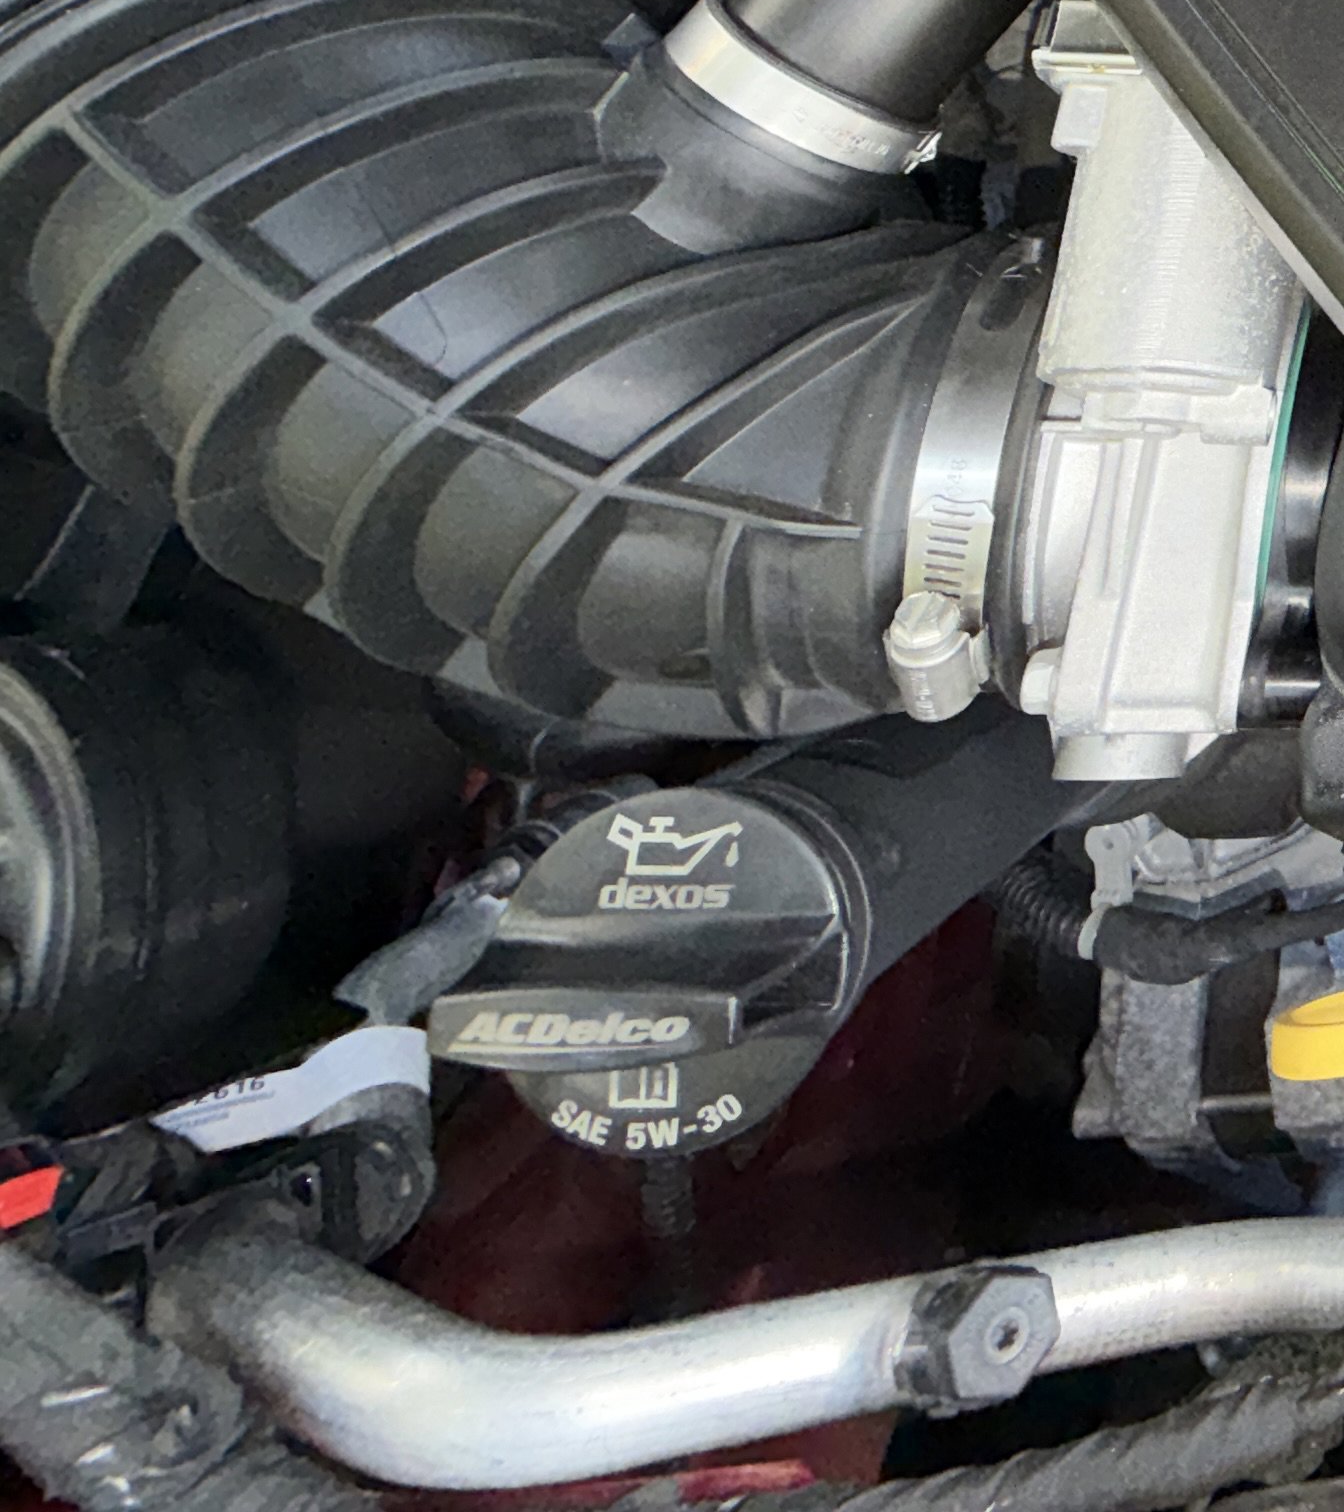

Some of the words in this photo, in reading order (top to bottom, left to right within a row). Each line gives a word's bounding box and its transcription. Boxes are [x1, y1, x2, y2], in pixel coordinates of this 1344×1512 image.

[599, 877, 736, 909] dexos
[456, 1011, 691, 1045] ACDelco
[550, 1098, 613, 1147] SAE
[625, 1093, 743, 1150] 5W-30
